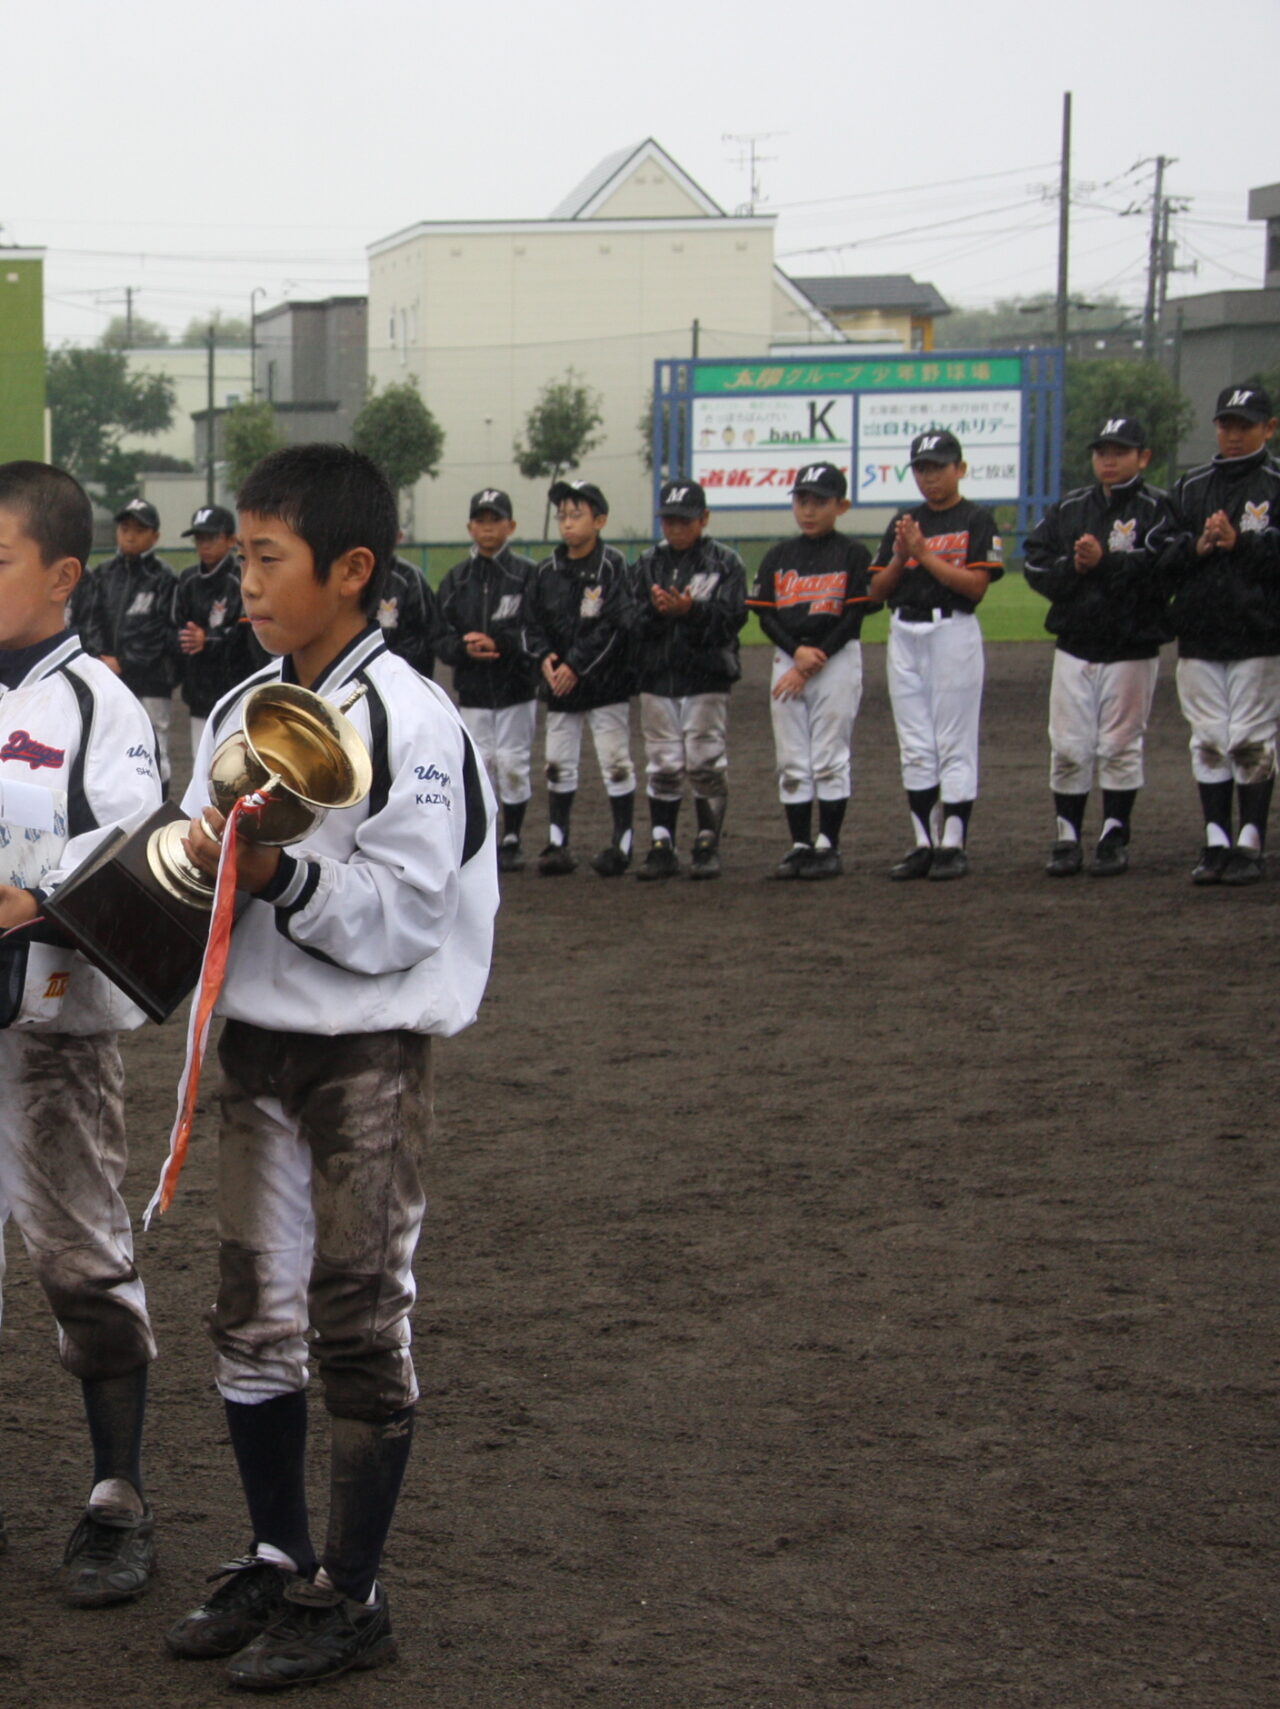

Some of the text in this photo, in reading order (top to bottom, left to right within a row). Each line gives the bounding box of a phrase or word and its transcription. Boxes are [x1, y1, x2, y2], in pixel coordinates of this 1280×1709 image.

[1226, 390, 1256, 407] M
[1100, 418, 1126, 436] M
[917, 436, 941, 454] M
[802, 467, 827, 483] M
[862, 464, 910, 489] STV
[666, 487, 689, 502] M
